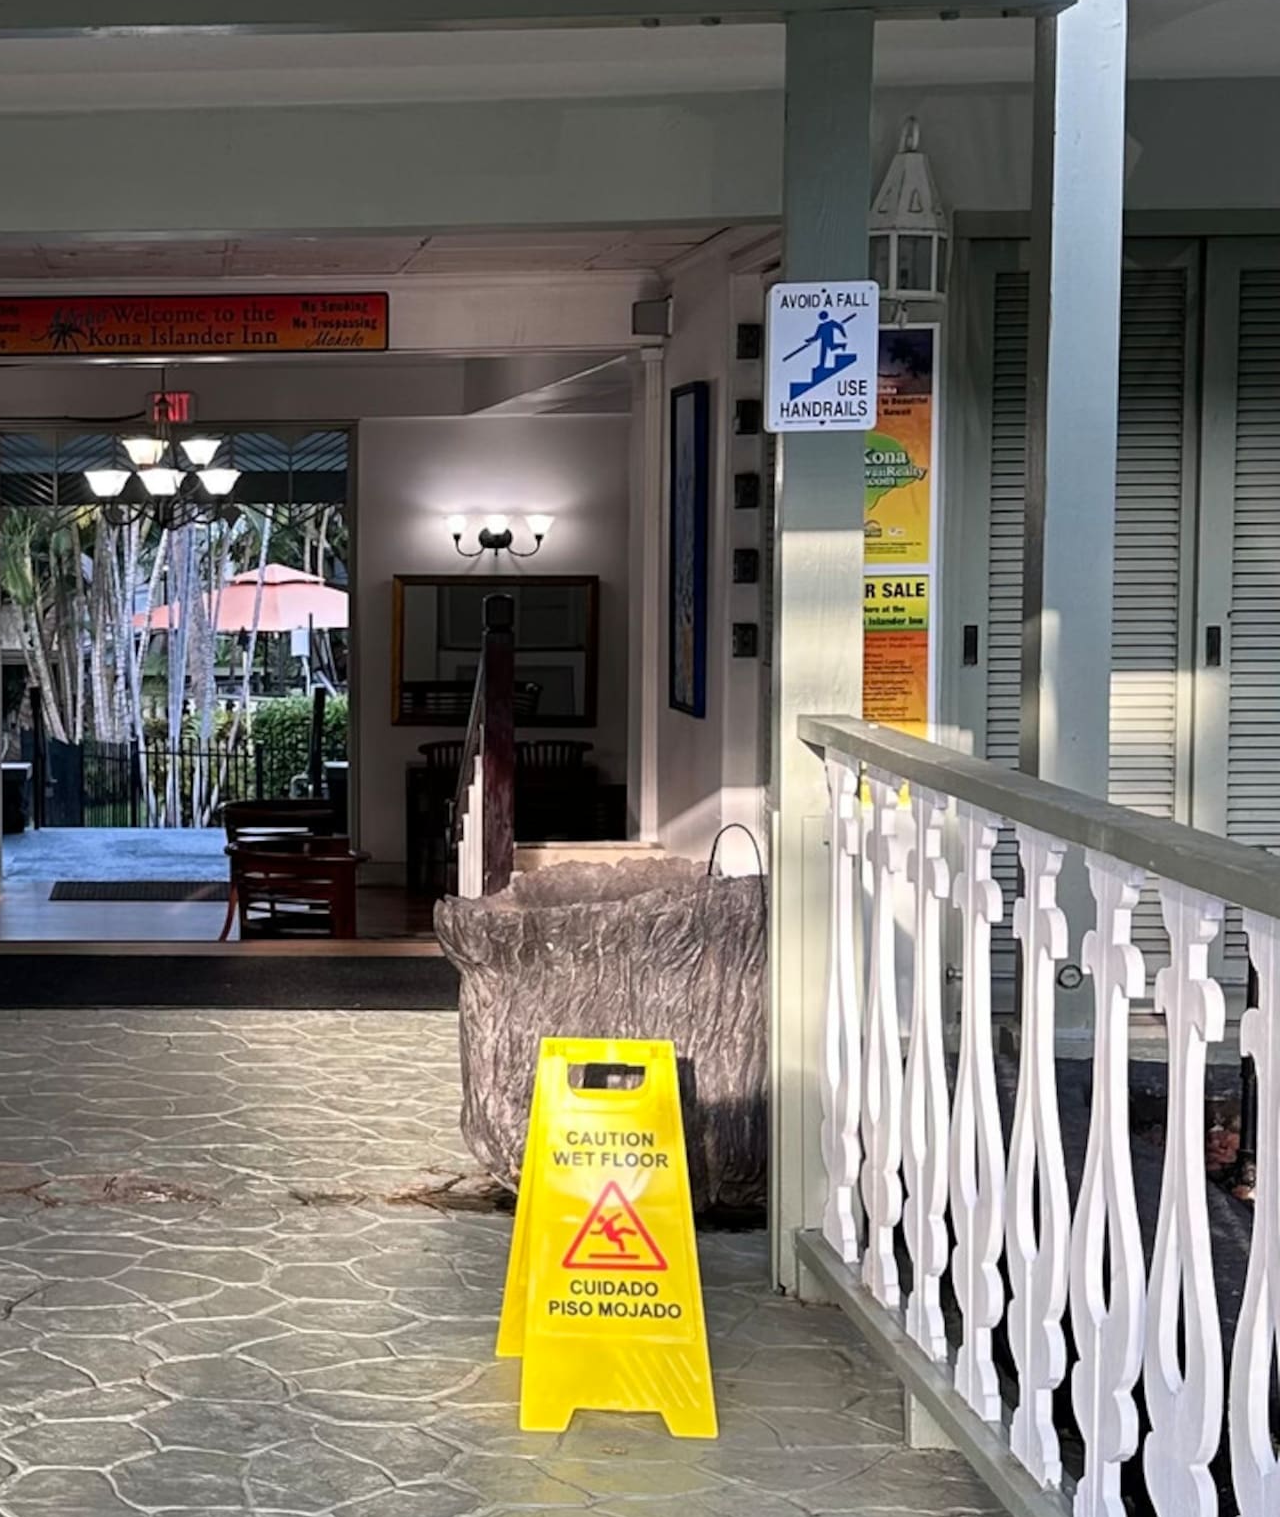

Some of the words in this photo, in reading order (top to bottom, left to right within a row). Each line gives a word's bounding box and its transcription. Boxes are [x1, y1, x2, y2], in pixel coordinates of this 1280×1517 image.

[321, 300, 369, 313] Smoking
[780, 294, 820, 309] AVOID
[824, 293, 833, 307] A
[837, 293, 869, 307] FALL
[111, 302, 207, 324] Welcome
[213, 306, 235, 323] to
[242, 301, 276, 322] the
[292, 316, 307, 329] No
[311, 316, 378, 331] Trespassing
[88, 325, 142, 346] Kona
[150, 324, 235, 345] Islander
[242, 324, 278, 344] Inn
[837, 380, 868, 396] USE
[780, 400, 868, 418] HANDRAILS
[882, 582, 925, 598] SALE
[566, 1131, 654, 1147] CAUTION
[553, 1151, 595, 1166] WET
[601, 1152, 668, 1168] FLOOR
[570, 1279, 658, 1297] CUIDADO
[549, 1300, 593, 1316] PISO
[599, 1301, 682, 1319] MOJADO
